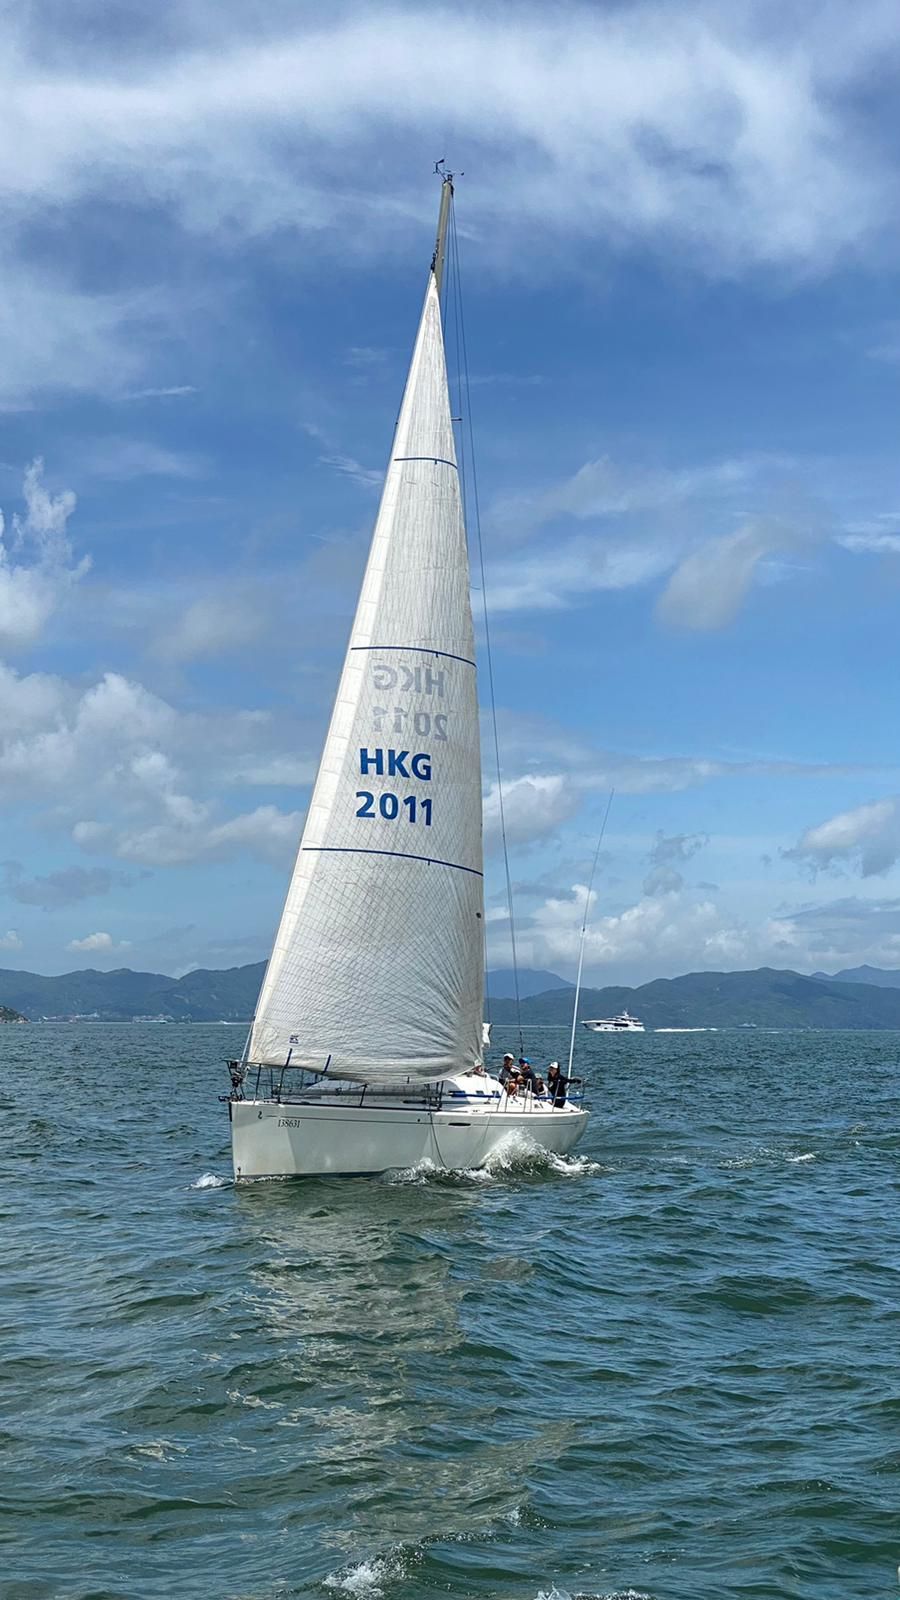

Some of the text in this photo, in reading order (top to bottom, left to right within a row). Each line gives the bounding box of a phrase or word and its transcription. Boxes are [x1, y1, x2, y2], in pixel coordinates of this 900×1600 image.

[360, 748, 432, 781] HKG
[356, 791, 432, 826] 2011
[278, 1119, 300, 1128] 138631
